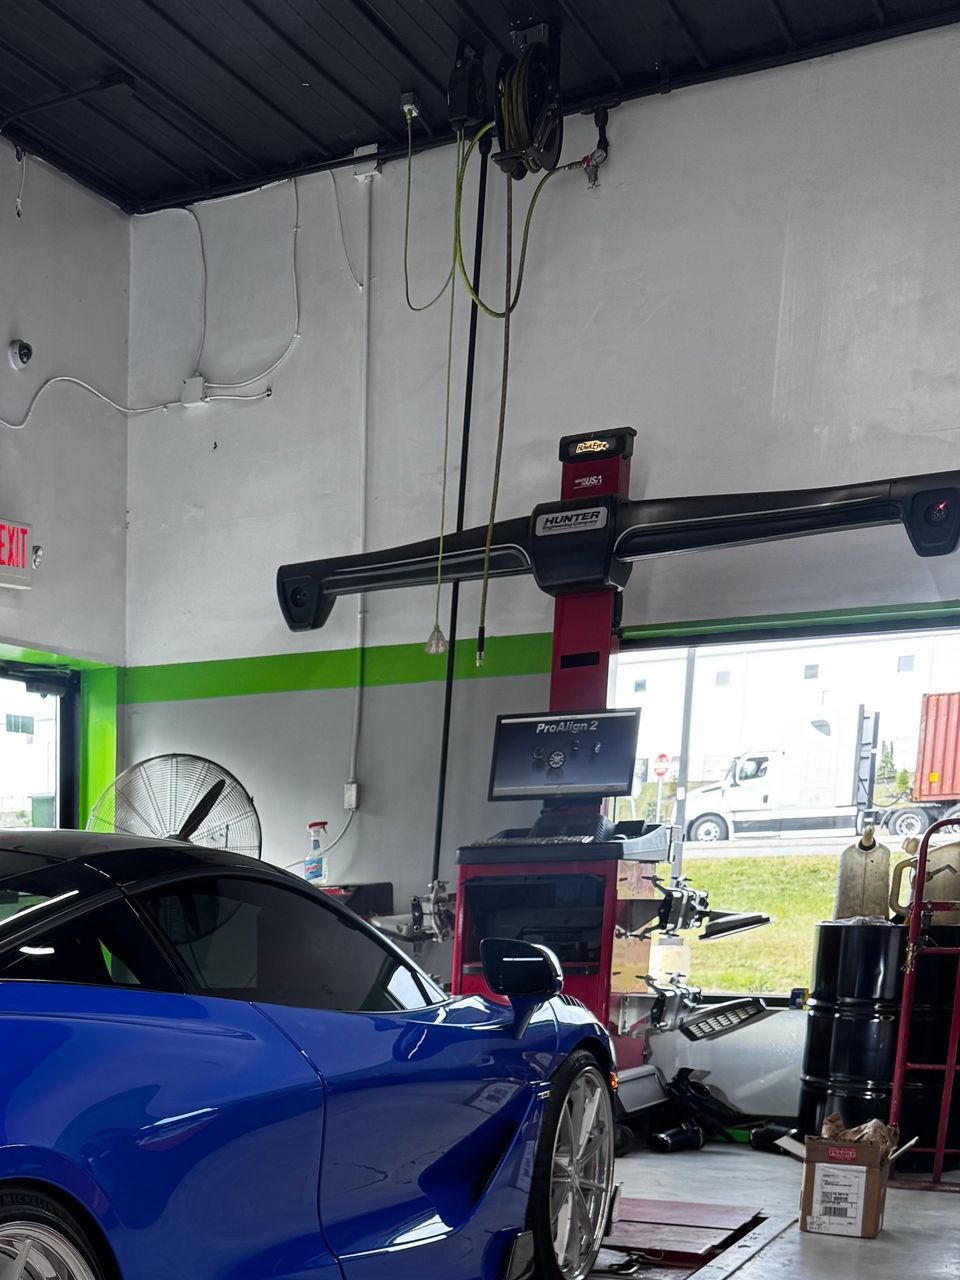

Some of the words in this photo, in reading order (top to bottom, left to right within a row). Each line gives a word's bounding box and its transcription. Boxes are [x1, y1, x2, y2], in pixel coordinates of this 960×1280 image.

[544, 511, 600, 526] HUNTER
[0, 524, 27, 568] EXIT
[536, 721, 587, 733] ProAlign
[589, 721, 598, 730] 2
